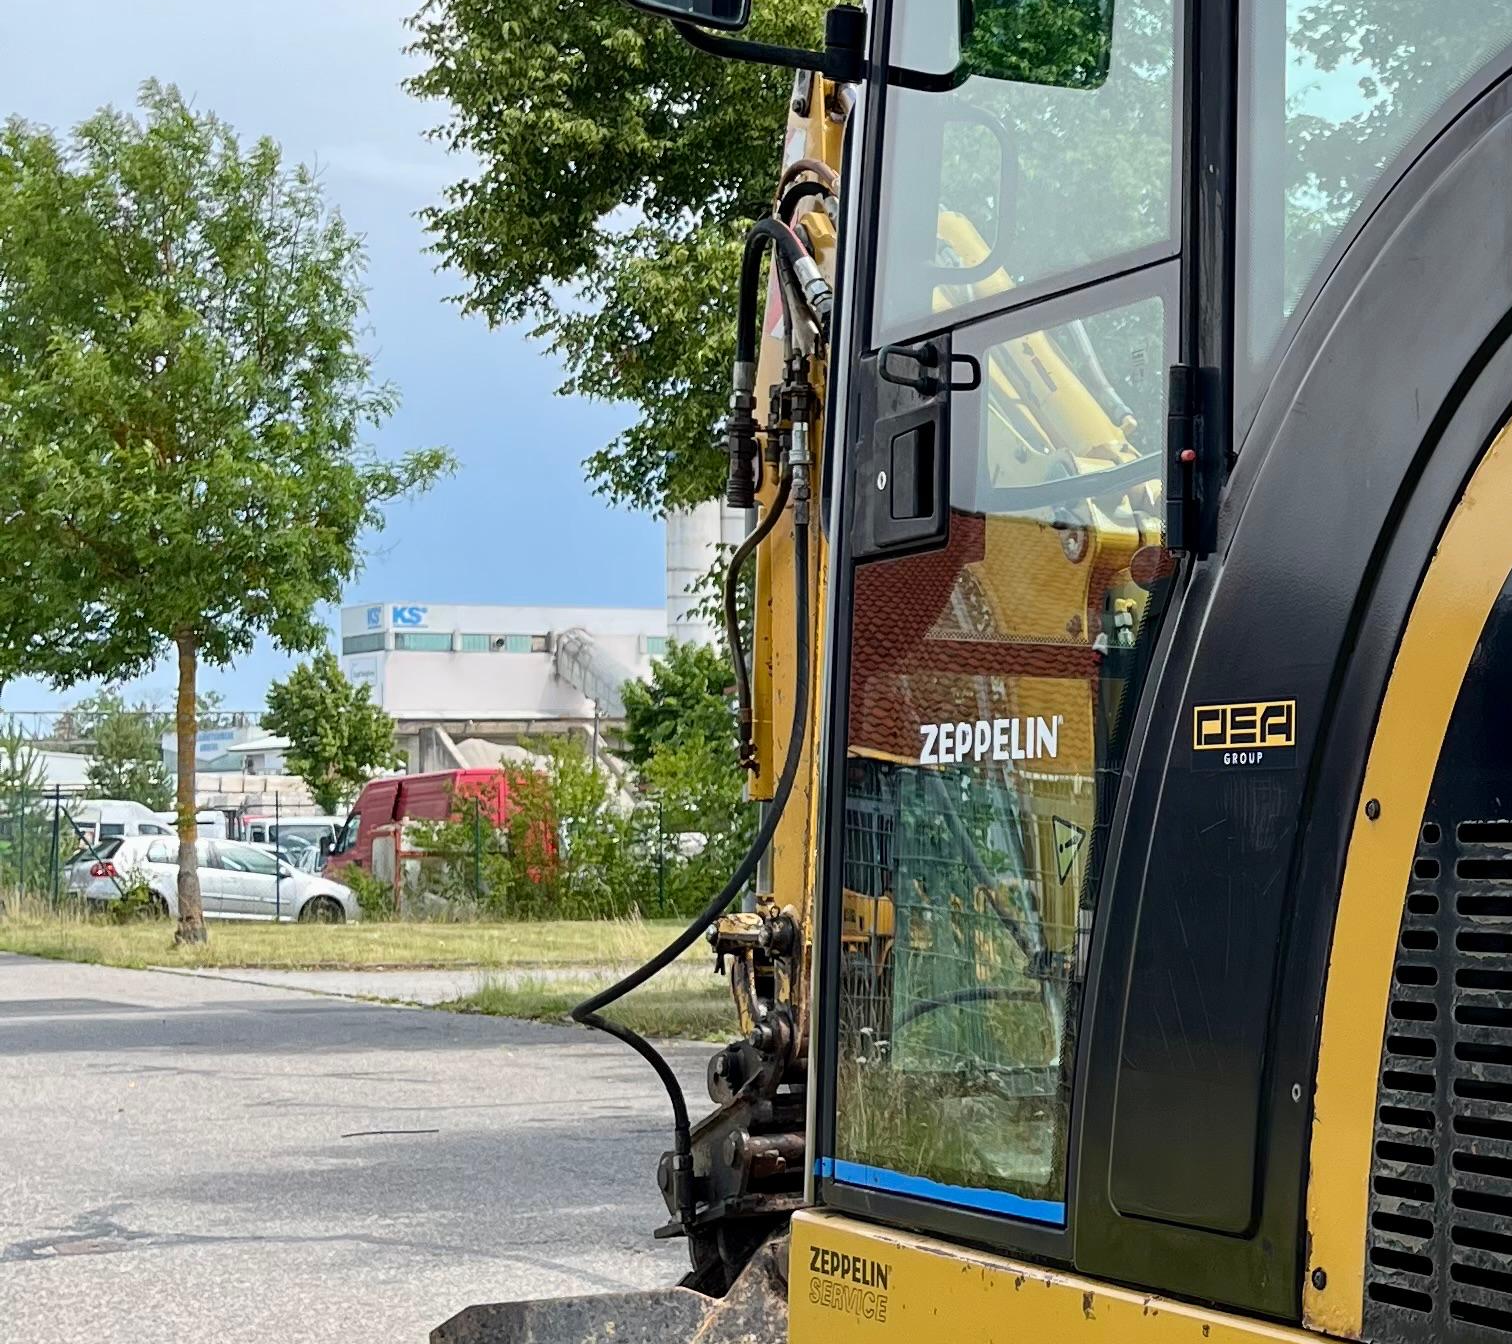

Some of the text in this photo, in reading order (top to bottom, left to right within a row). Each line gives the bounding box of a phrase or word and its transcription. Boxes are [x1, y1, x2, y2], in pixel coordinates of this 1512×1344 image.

[919, 715, 1059, 764] ZEPPELIN
[1223, 751, 1263, 765] GROUP
[809, 1245, 888, 1291] ZEPPELIN
[808, 1276, 889, 1324] SERVICE
